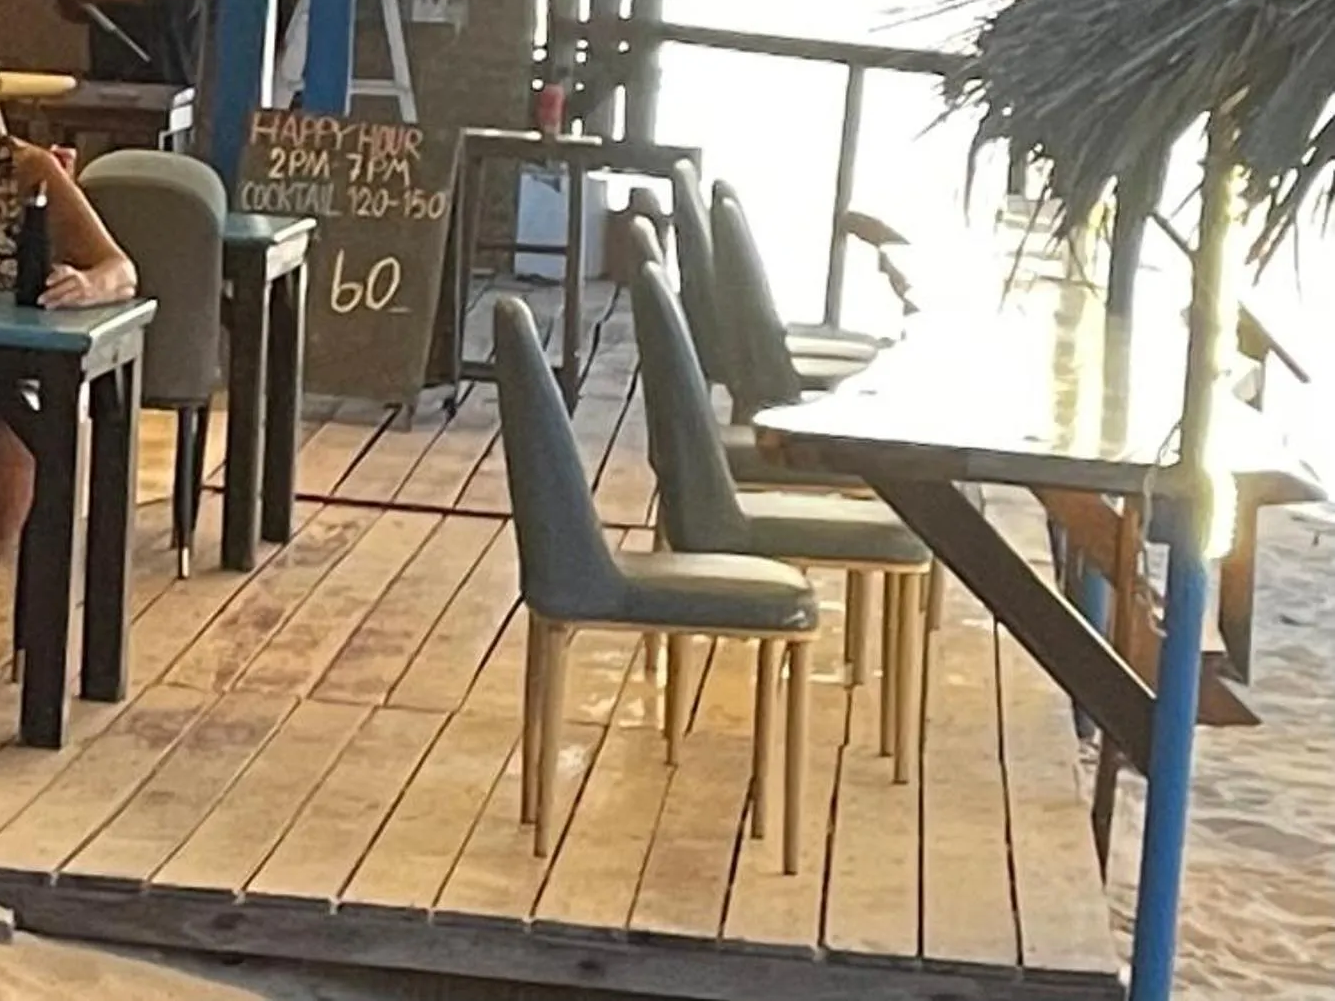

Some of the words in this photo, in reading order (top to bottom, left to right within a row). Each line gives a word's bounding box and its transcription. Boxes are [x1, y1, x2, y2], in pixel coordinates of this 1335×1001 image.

[250, 111, 358, 150] HAPPY
[358, 122, 423, 159] HOUR
[268, 147, 330, 180] 2PM
[241, 181, 342, 217] COCKTAIL
[347, 185, 446, 219] 120-150
